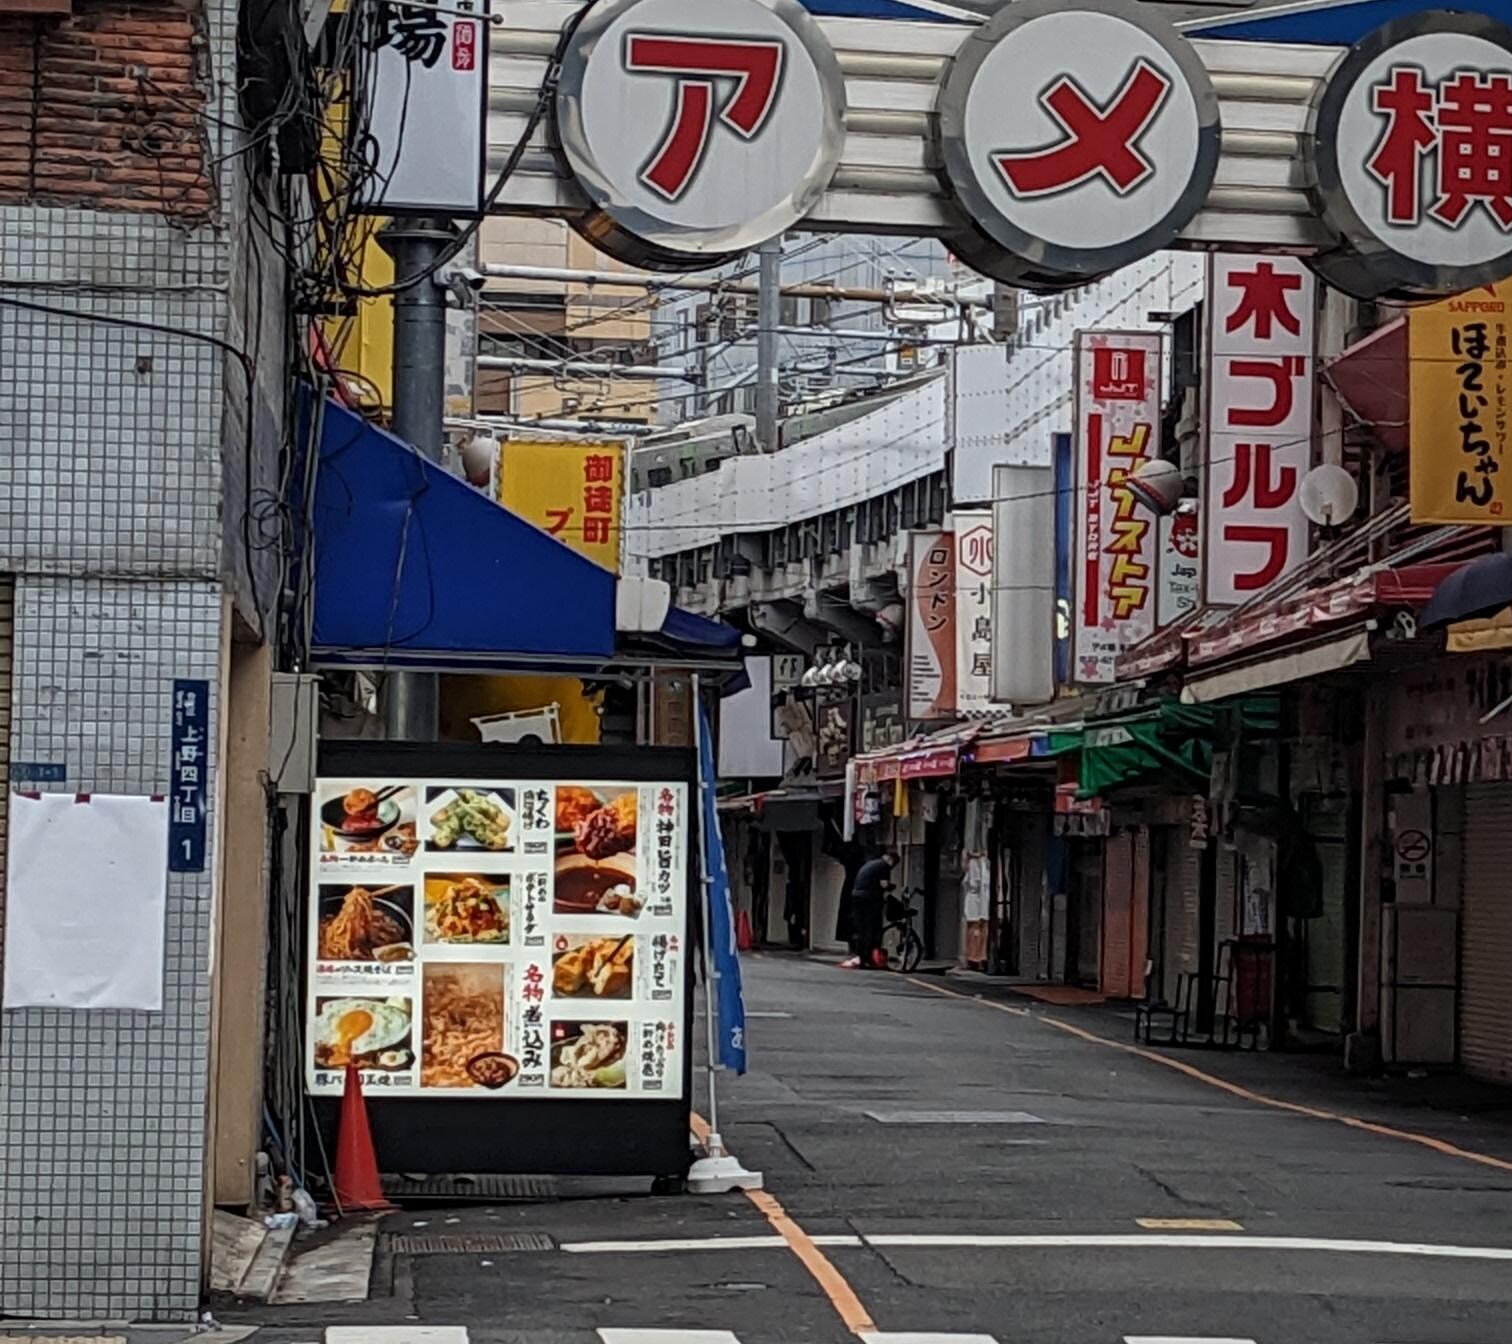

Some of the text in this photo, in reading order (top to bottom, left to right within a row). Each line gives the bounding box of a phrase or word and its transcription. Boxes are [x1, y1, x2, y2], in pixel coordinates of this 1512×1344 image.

[1452, 322, 1499, 506] ほていちゃん
[583, 454, 614, 544] 御徒町
[927, 549, 949, 632] ロンドン
[182, 839, 192, 861] 1
[522, 963, 544, 1002] 名物
